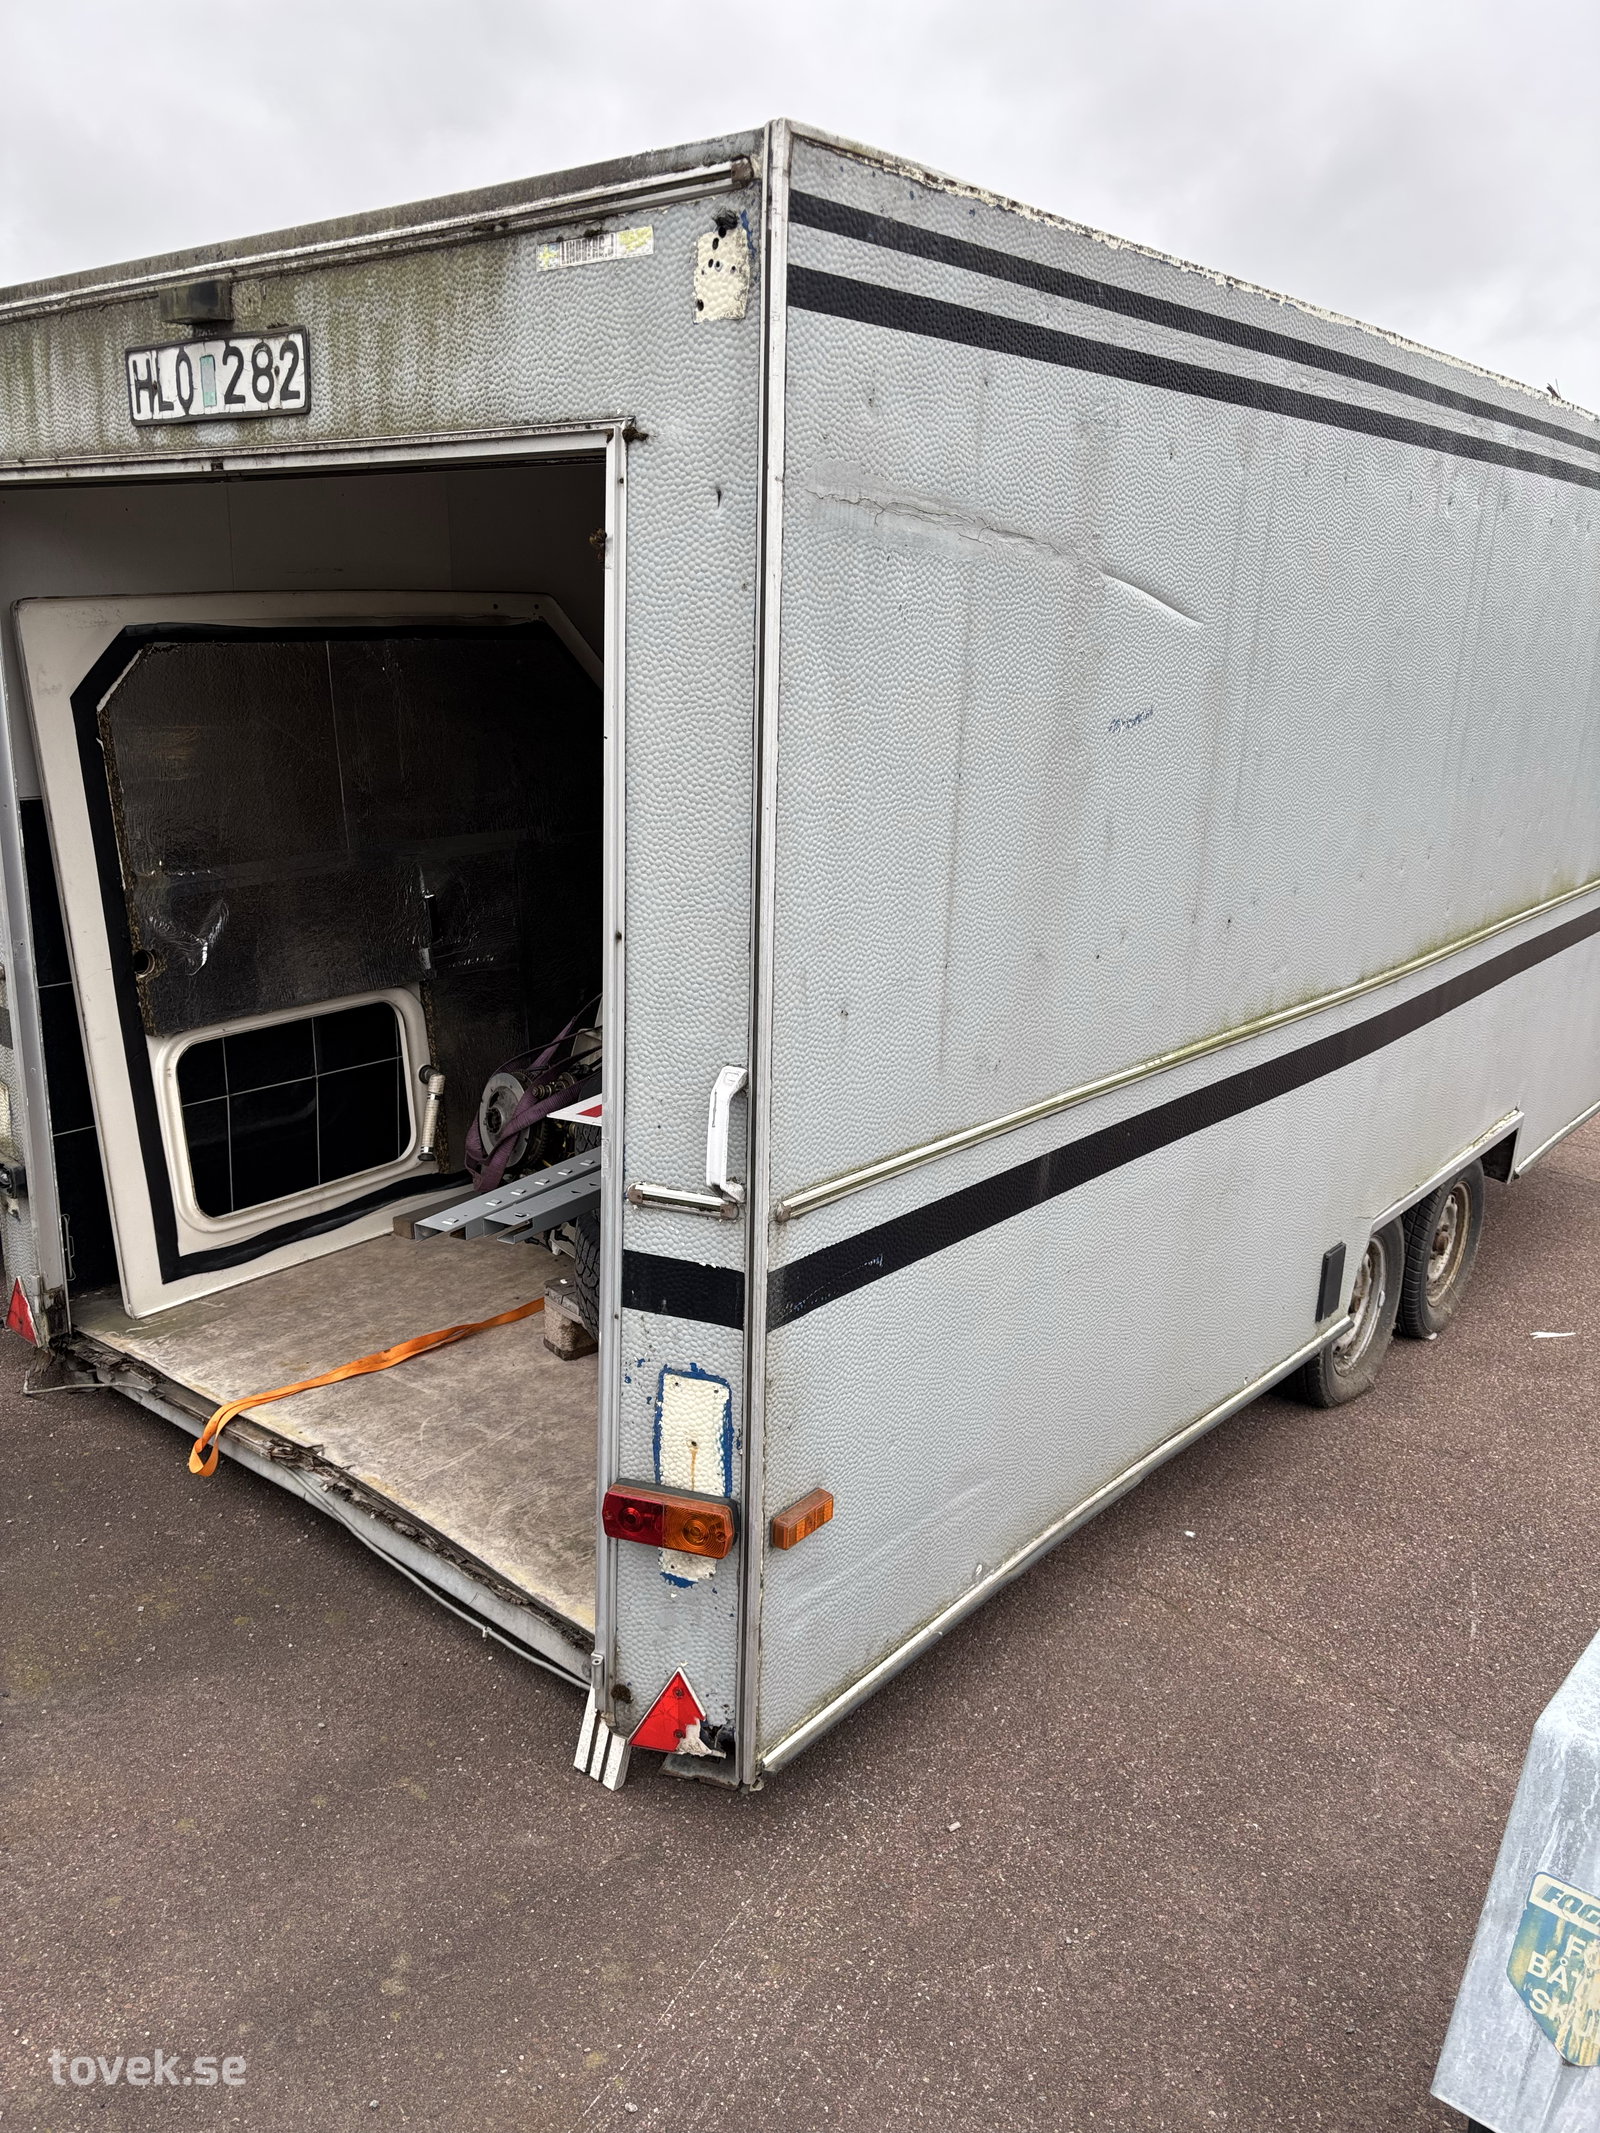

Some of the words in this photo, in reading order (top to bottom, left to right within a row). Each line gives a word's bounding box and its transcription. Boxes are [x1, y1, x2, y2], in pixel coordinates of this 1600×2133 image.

[132, 348, 194, 414] HLO
[222, 340, 300, 404] 282
[1541, 1886, 1600, 1925] FOG
